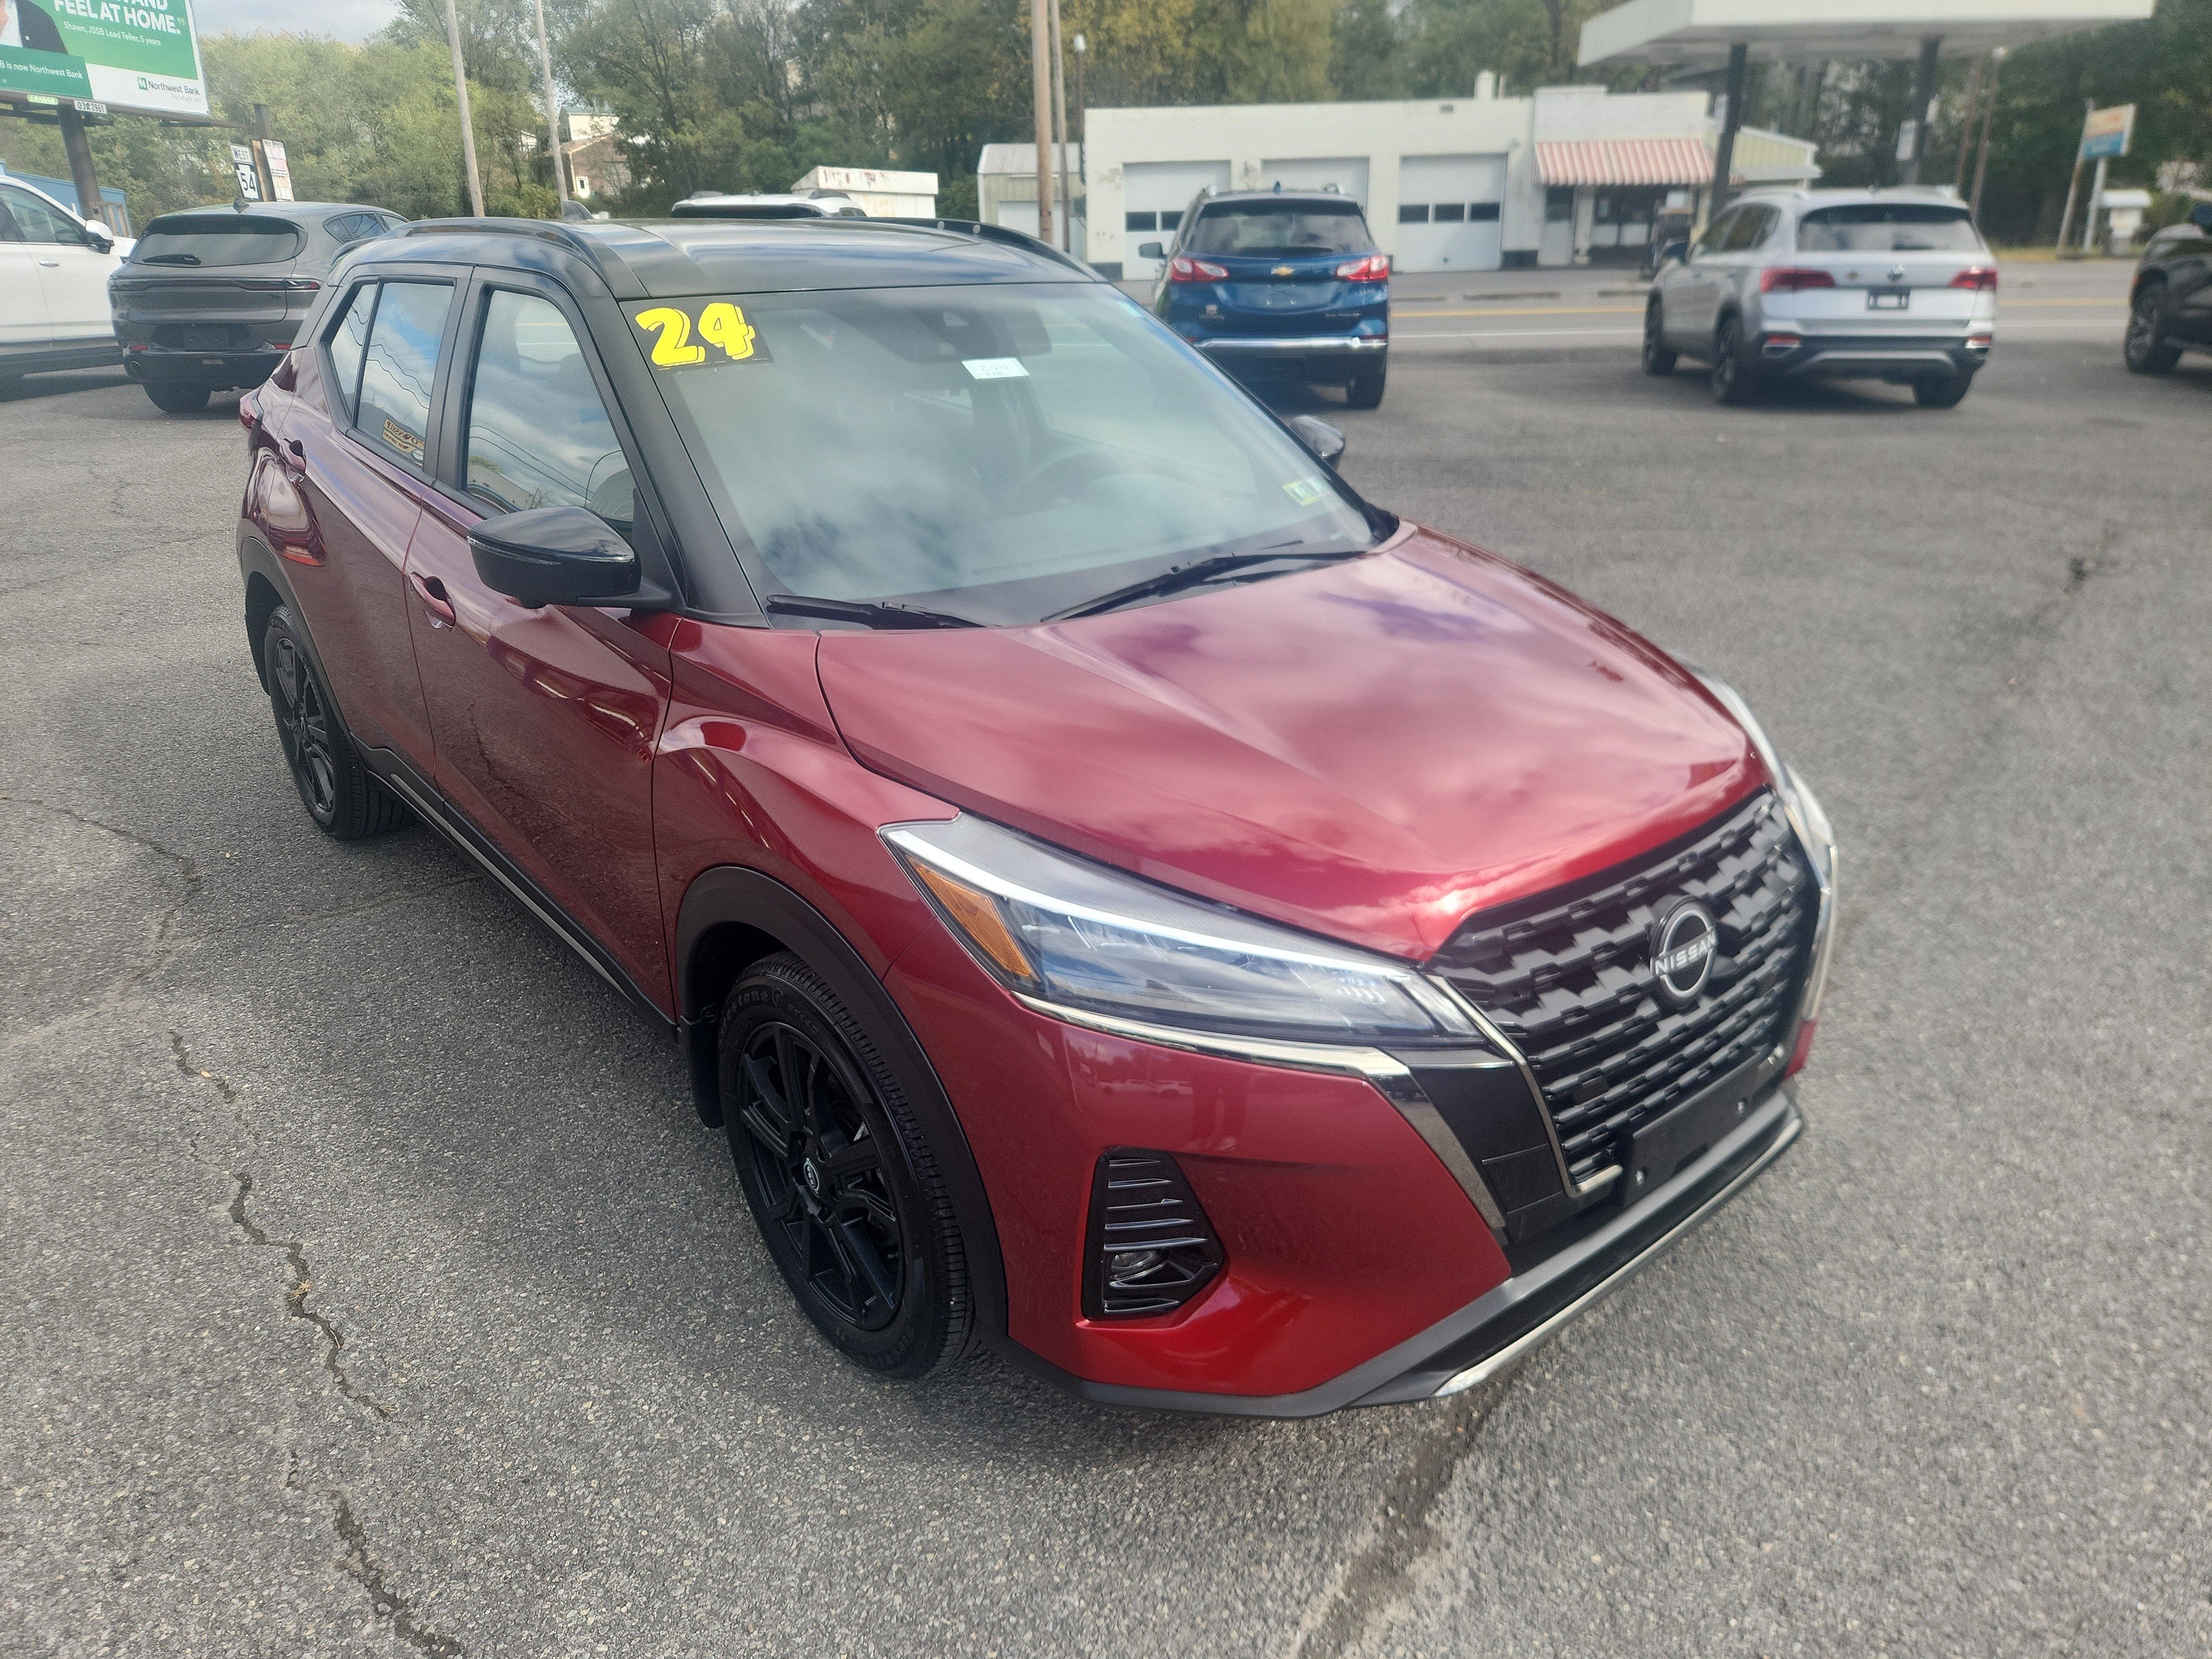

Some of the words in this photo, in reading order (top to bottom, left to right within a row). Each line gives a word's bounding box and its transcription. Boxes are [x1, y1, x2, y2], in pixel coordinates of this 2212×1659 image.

[54, 0, 99, 19] FEEL
[100, 2, 121, 23] AT
[63, 21, 87, 33] Shawn,
[88, 27, 105, 36] JSSB
[105, 29, 121, 38] Lead
[121, 31, 140, 42] Teller,
[145, 37, 162, 46] years
[6, 61, 12, 69] is
[29, 64, 66, 76] Northwest
[66, 69, 83, 79] Bank
[148, 80, 183, 93] Northwest
[184, 86, 200, 95] Bank
[233, 147, 249, 160] WEST
[240, 172, 256, 192] 54
[635, 302, 756, 366] 24
[1655, 931, 1715, 975] NISSAN
